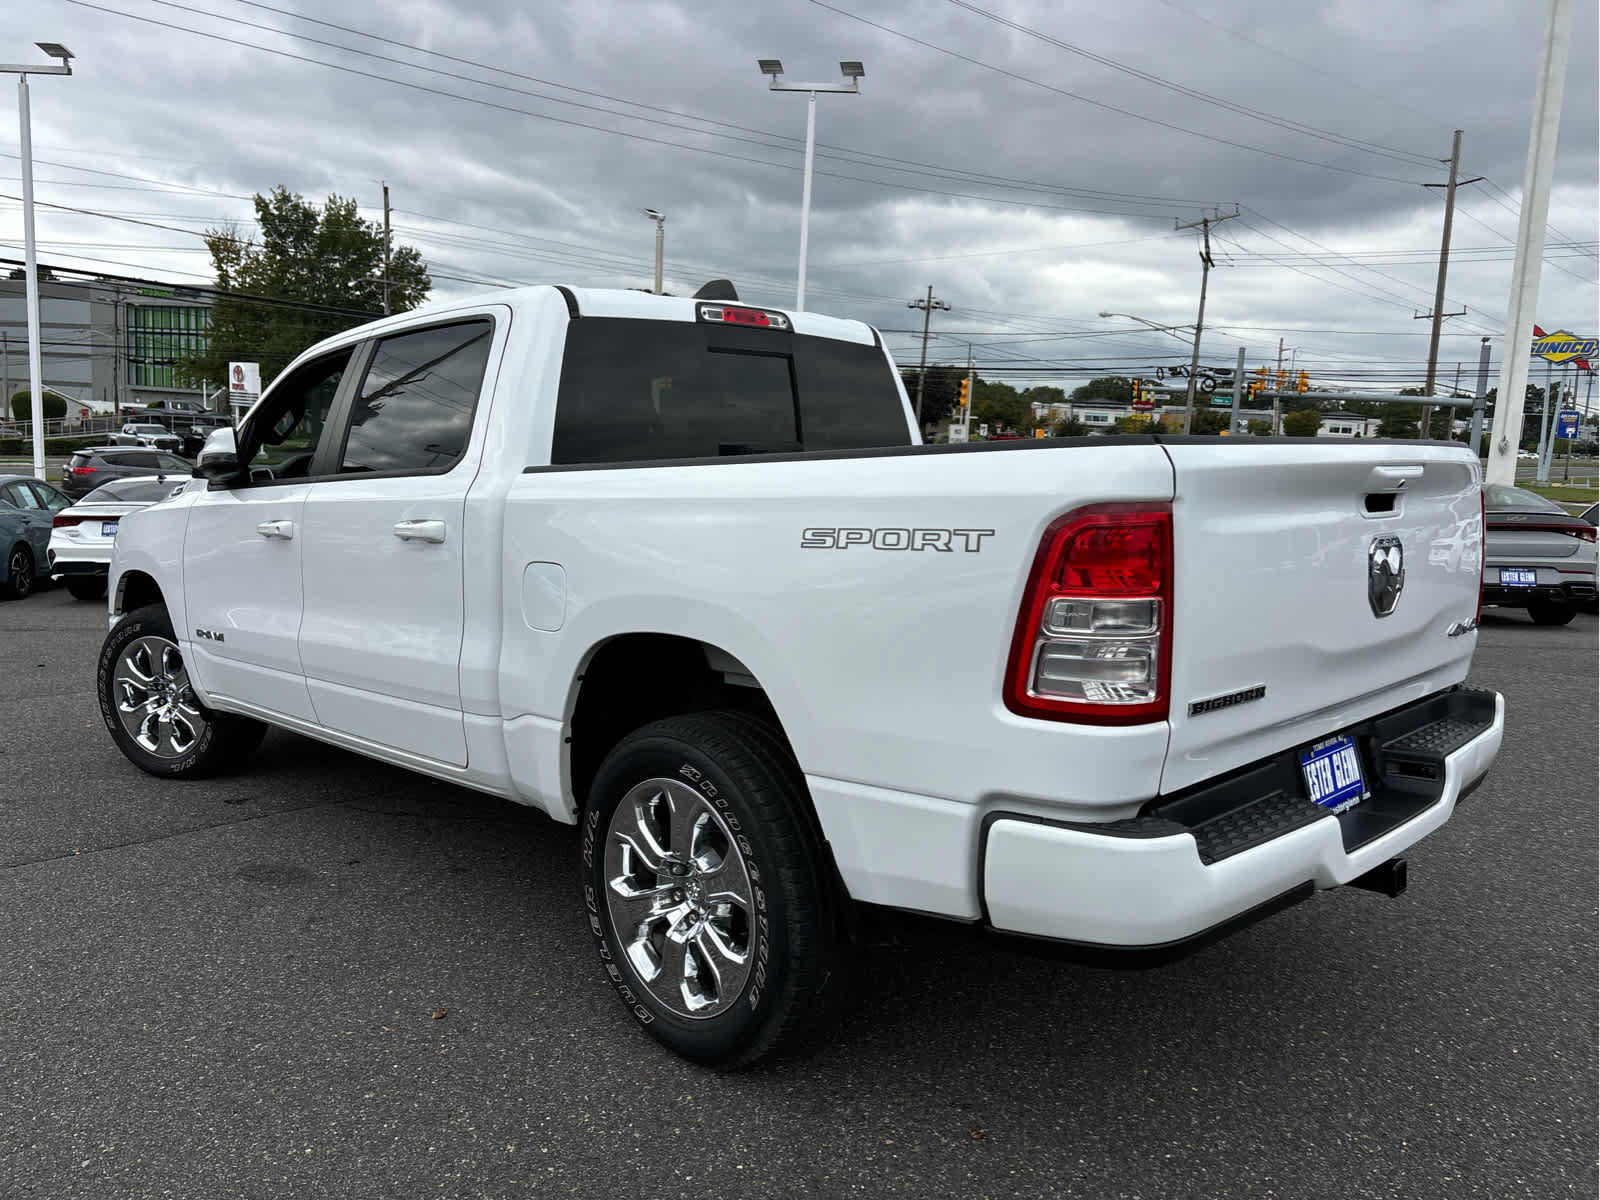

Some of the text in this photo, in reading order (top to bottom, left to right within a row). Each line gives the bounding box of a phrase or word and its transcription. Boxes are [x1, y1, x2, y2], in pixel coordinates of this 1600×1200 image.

[800, 527, 995, 552] SPORT
[1303, 756, 1335, 803] LESTER
[1332, 746, 1361, 789] GLENN
[678, 763, 769, 1012] BRIDGESTONE
